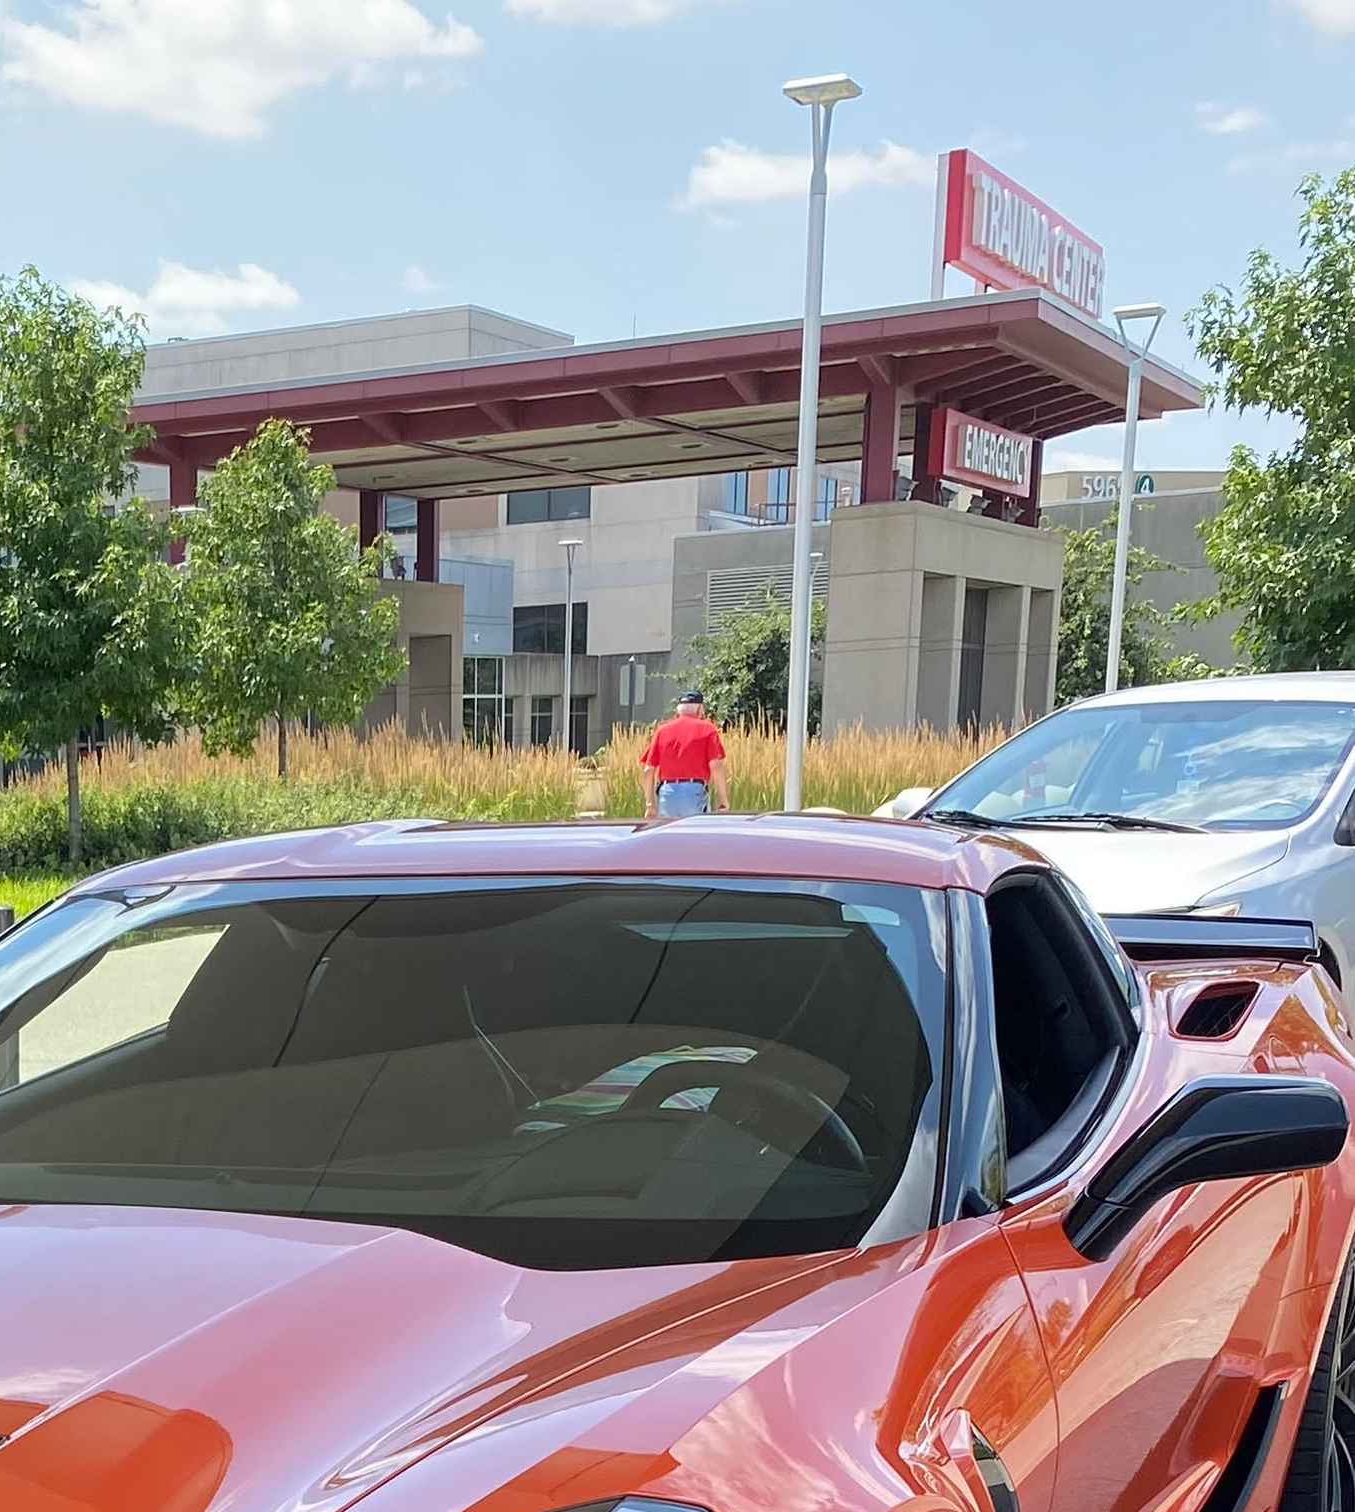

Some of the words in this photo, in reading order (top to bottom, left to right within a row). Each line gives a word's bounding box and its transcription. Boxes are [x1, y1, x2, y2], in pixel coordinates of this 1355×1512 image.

[974, 171, 1048, 284] TRAUMA
[1051, 225, 1105, 318] CENTER
[964, 424, 1030, 486] EMERGENCY
